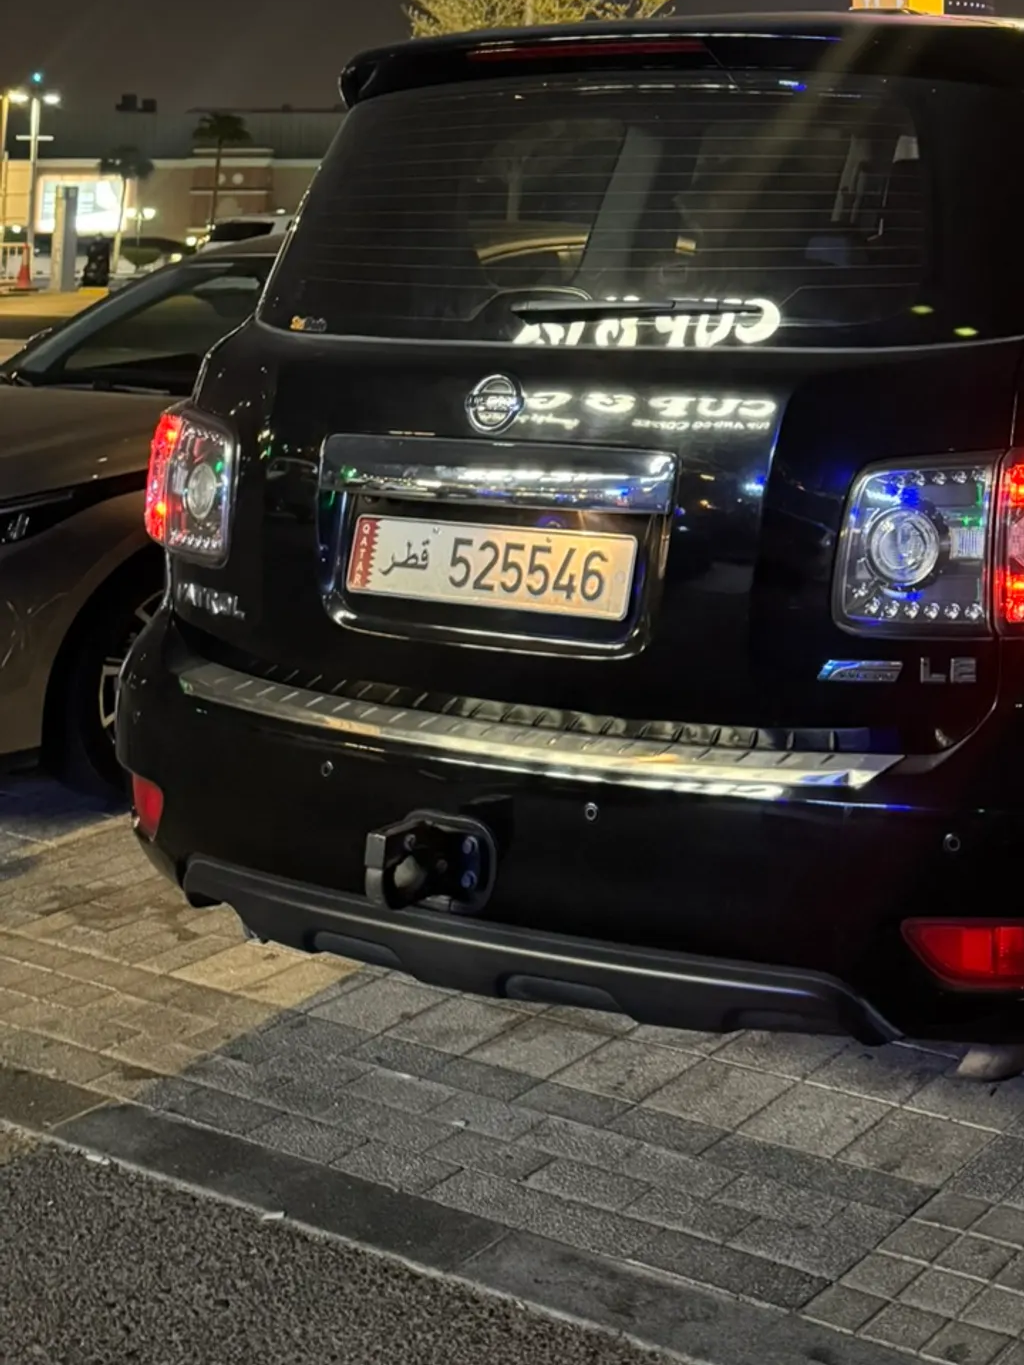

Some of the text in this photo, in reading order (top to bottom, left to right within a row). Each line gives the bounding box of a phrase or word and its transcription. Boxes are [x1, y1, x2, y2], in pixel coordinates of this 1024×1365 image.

[353, 523, 371, 587] QATAR
[378, 537, 609, 601] قطر 525546
[920, 656, 976, 683] LE
